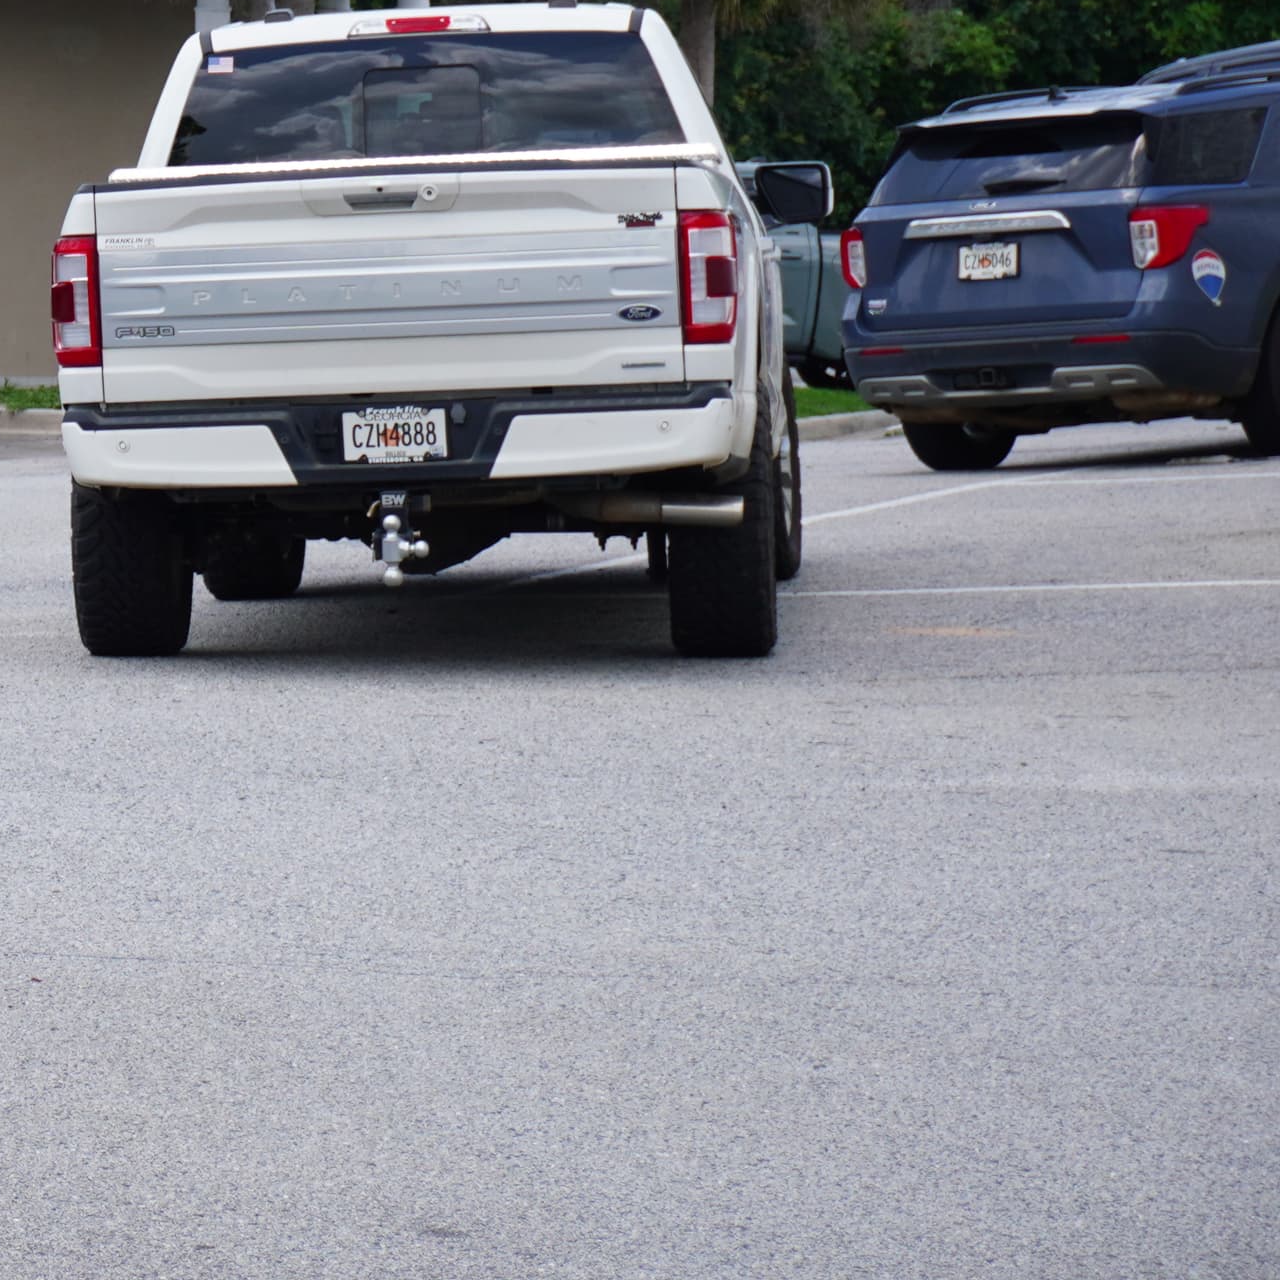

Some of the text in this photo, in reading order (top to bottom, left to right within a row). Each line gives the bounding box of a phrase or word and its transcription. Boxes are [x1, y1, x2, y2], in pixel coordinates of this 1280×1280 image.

[105, 237, 144, 245] FRANKLIN
[964, 251, 1012, 270] CZH5046
[191, 274, 582, 306] PLATINUM
[365, 406, 422, 416] Franklin
[352, 421, 438, 449] CZH4888
[381, 494, 406, 505] BW
